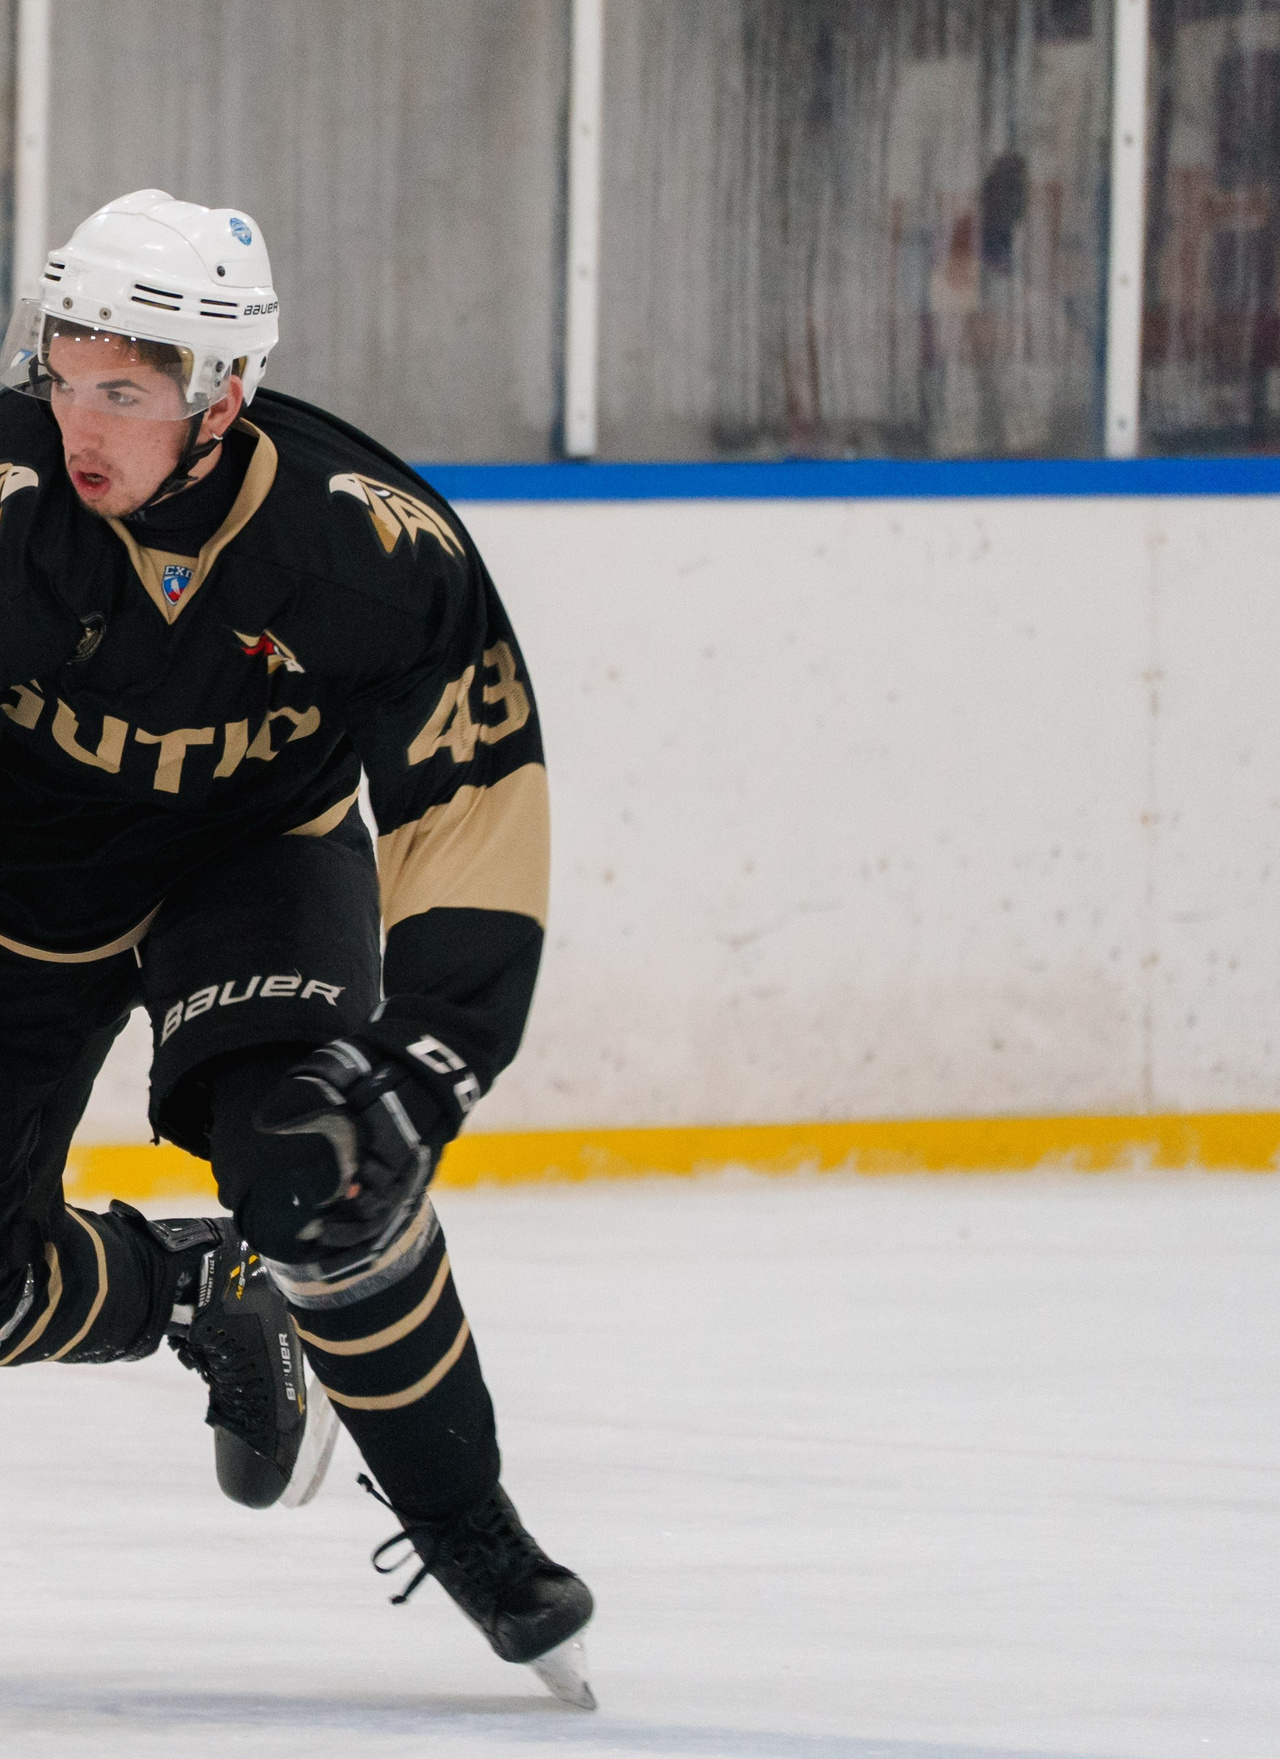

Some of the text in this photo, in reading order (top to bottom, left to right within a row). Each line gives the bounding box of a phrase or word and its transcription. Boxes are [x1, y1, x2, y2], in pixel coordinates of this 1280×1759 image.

[406, 640, 531, 767] 43
[159, 970, 347, 1048] BAUER
[278, 1333, 297, 1401] BUER
